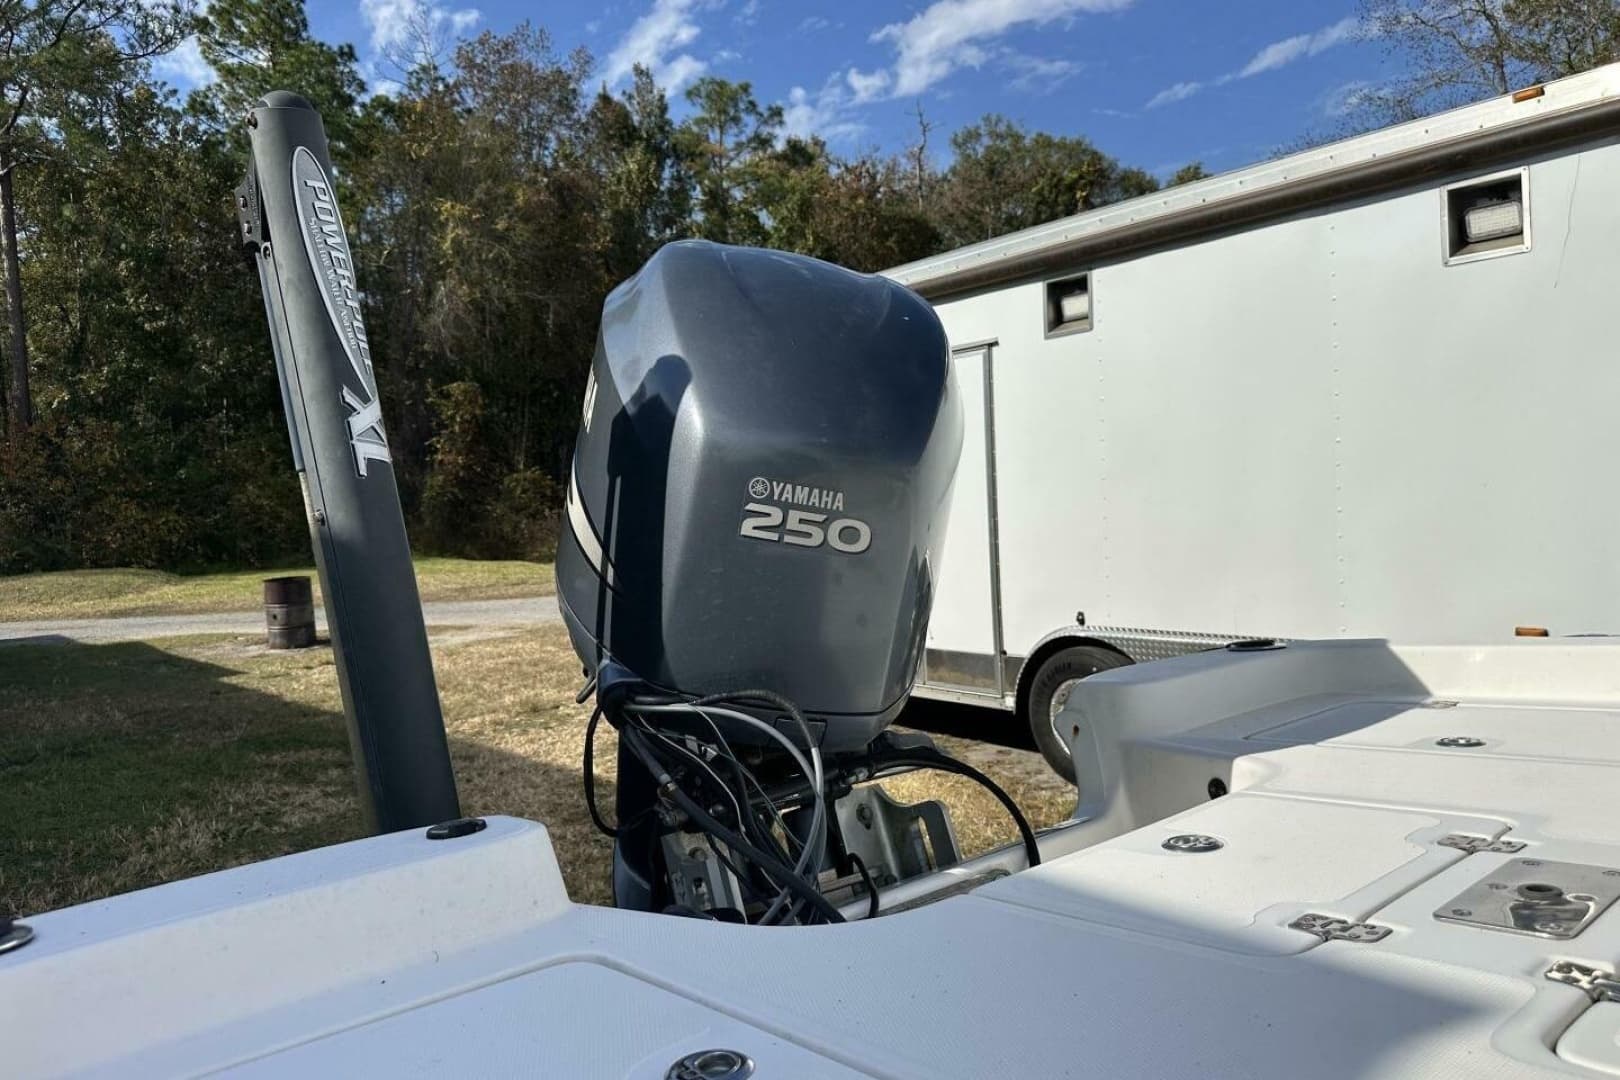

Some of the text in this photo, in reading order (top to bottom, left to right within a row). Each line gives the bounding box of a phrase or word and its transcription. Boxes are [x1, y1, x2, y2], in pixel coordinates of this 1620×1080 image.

[341, 384, 392, 478] XL
[772, 481, 844, 511] YAMAHA
[740, 502, 872, 553] 250
